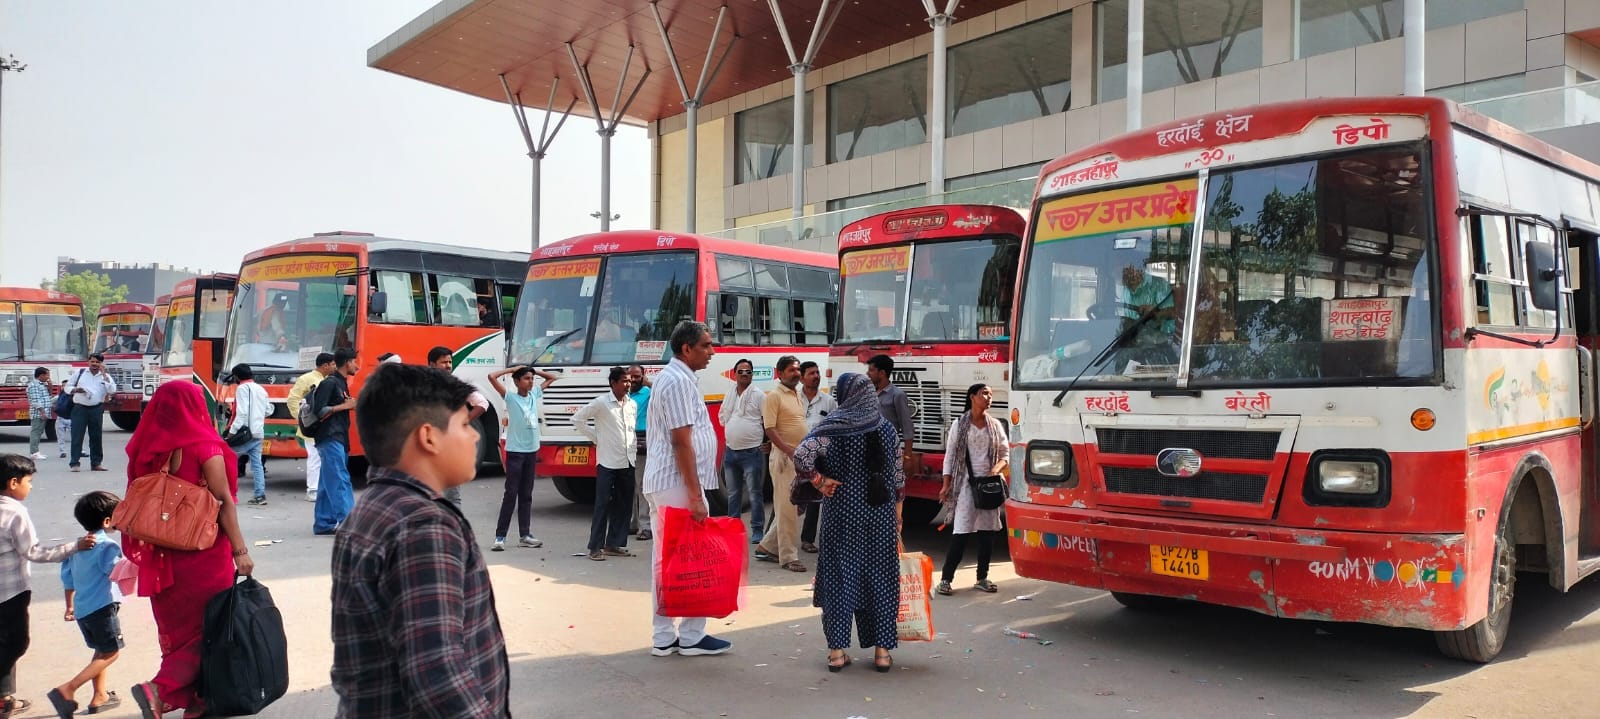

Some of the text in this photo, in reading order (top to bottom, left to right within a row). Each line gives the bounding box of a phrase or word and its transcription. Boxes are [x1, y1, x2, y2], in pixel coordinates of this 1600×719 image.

[1156, 114, 1253, 147] हरदोई क्षेत्र
[1332, 118, 1391, 145] डिपो
[1099, 194, 1150, 225] उत्तर
[890, 371, 918, 382] TATA
[1084, 391, 1131, 412] हरदोई
[1224, 391, 1271, 412] बरेली
[1162, 558, 1200, 576] T4410
